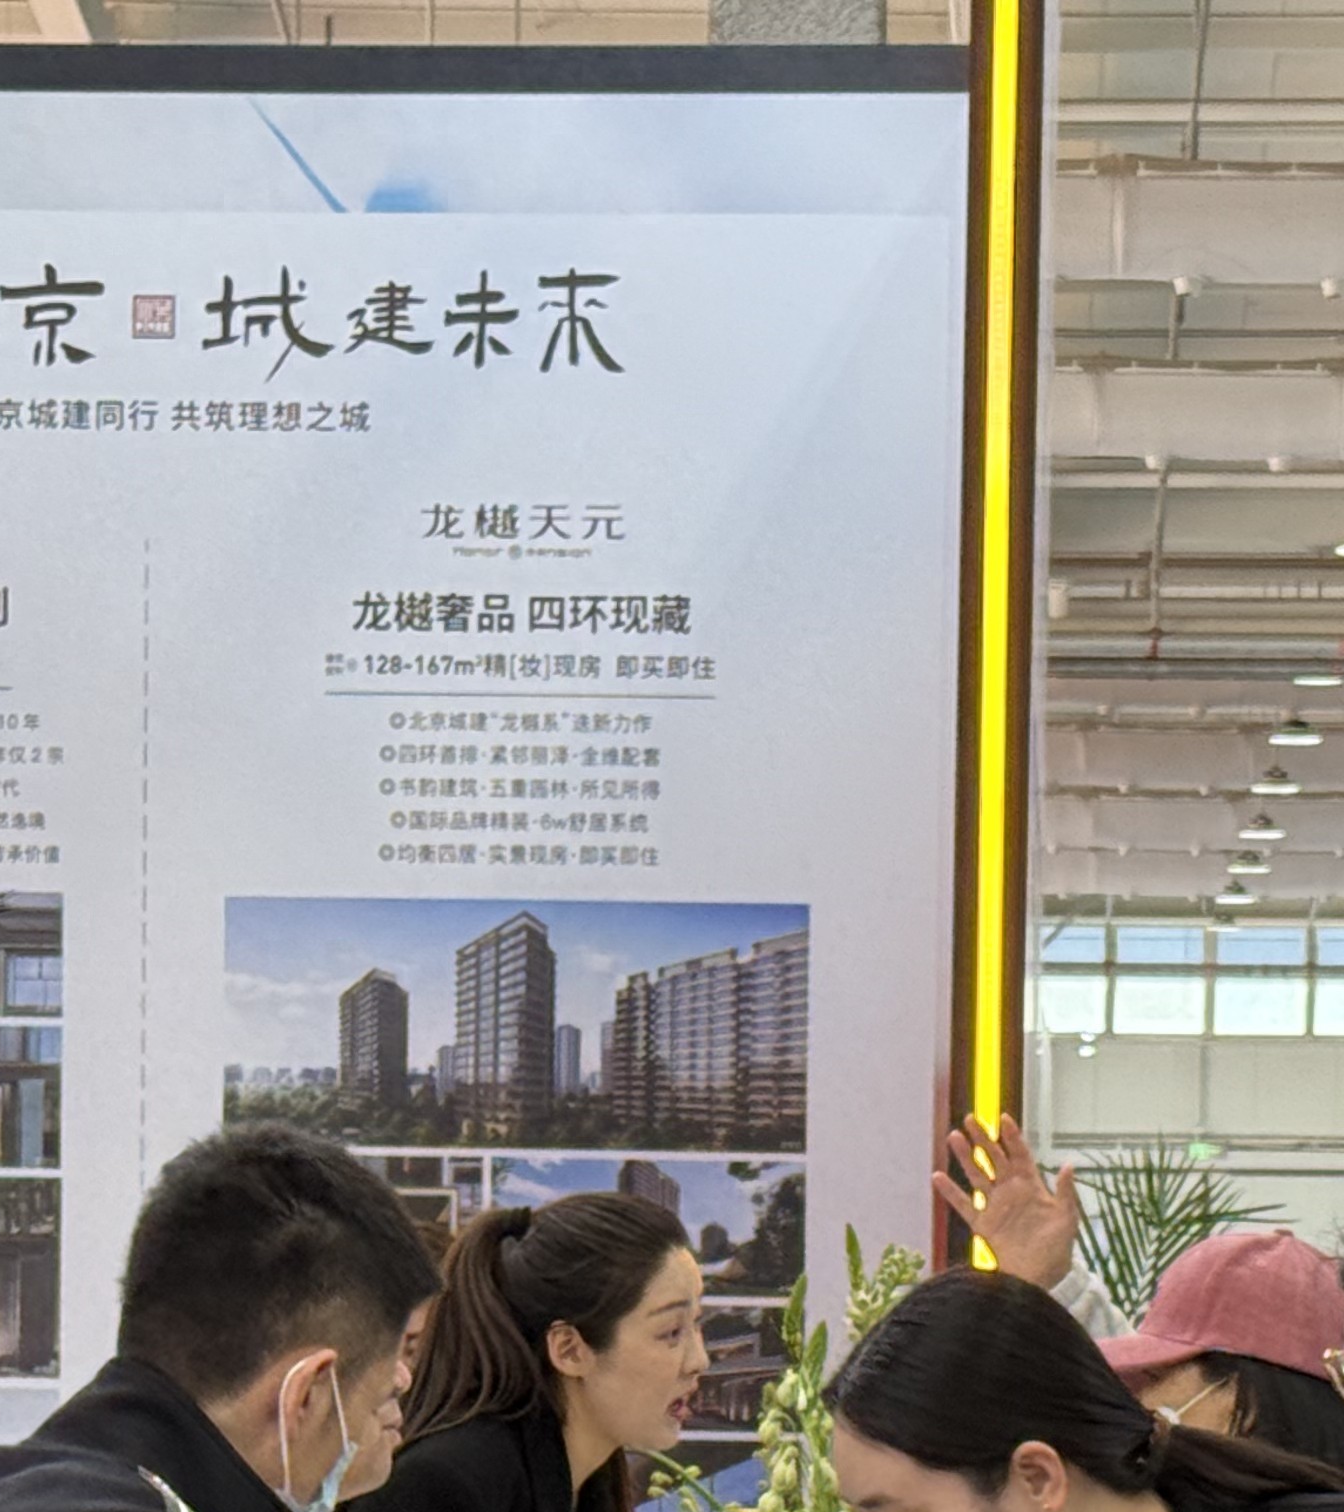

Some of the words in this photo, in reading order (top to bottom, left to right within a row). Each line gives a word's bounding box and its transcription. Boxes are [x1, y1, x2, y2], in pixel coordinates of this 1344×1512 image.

[171, 400, 371, 432] 共筑理想之城
[420, 503, 626, 541] 龙樾天元
[352, 590, 515, 634] 龙樾奢品
[528, 594, 693, 635] 四环现藏
[615, 654, 717, 681] 即买即住
